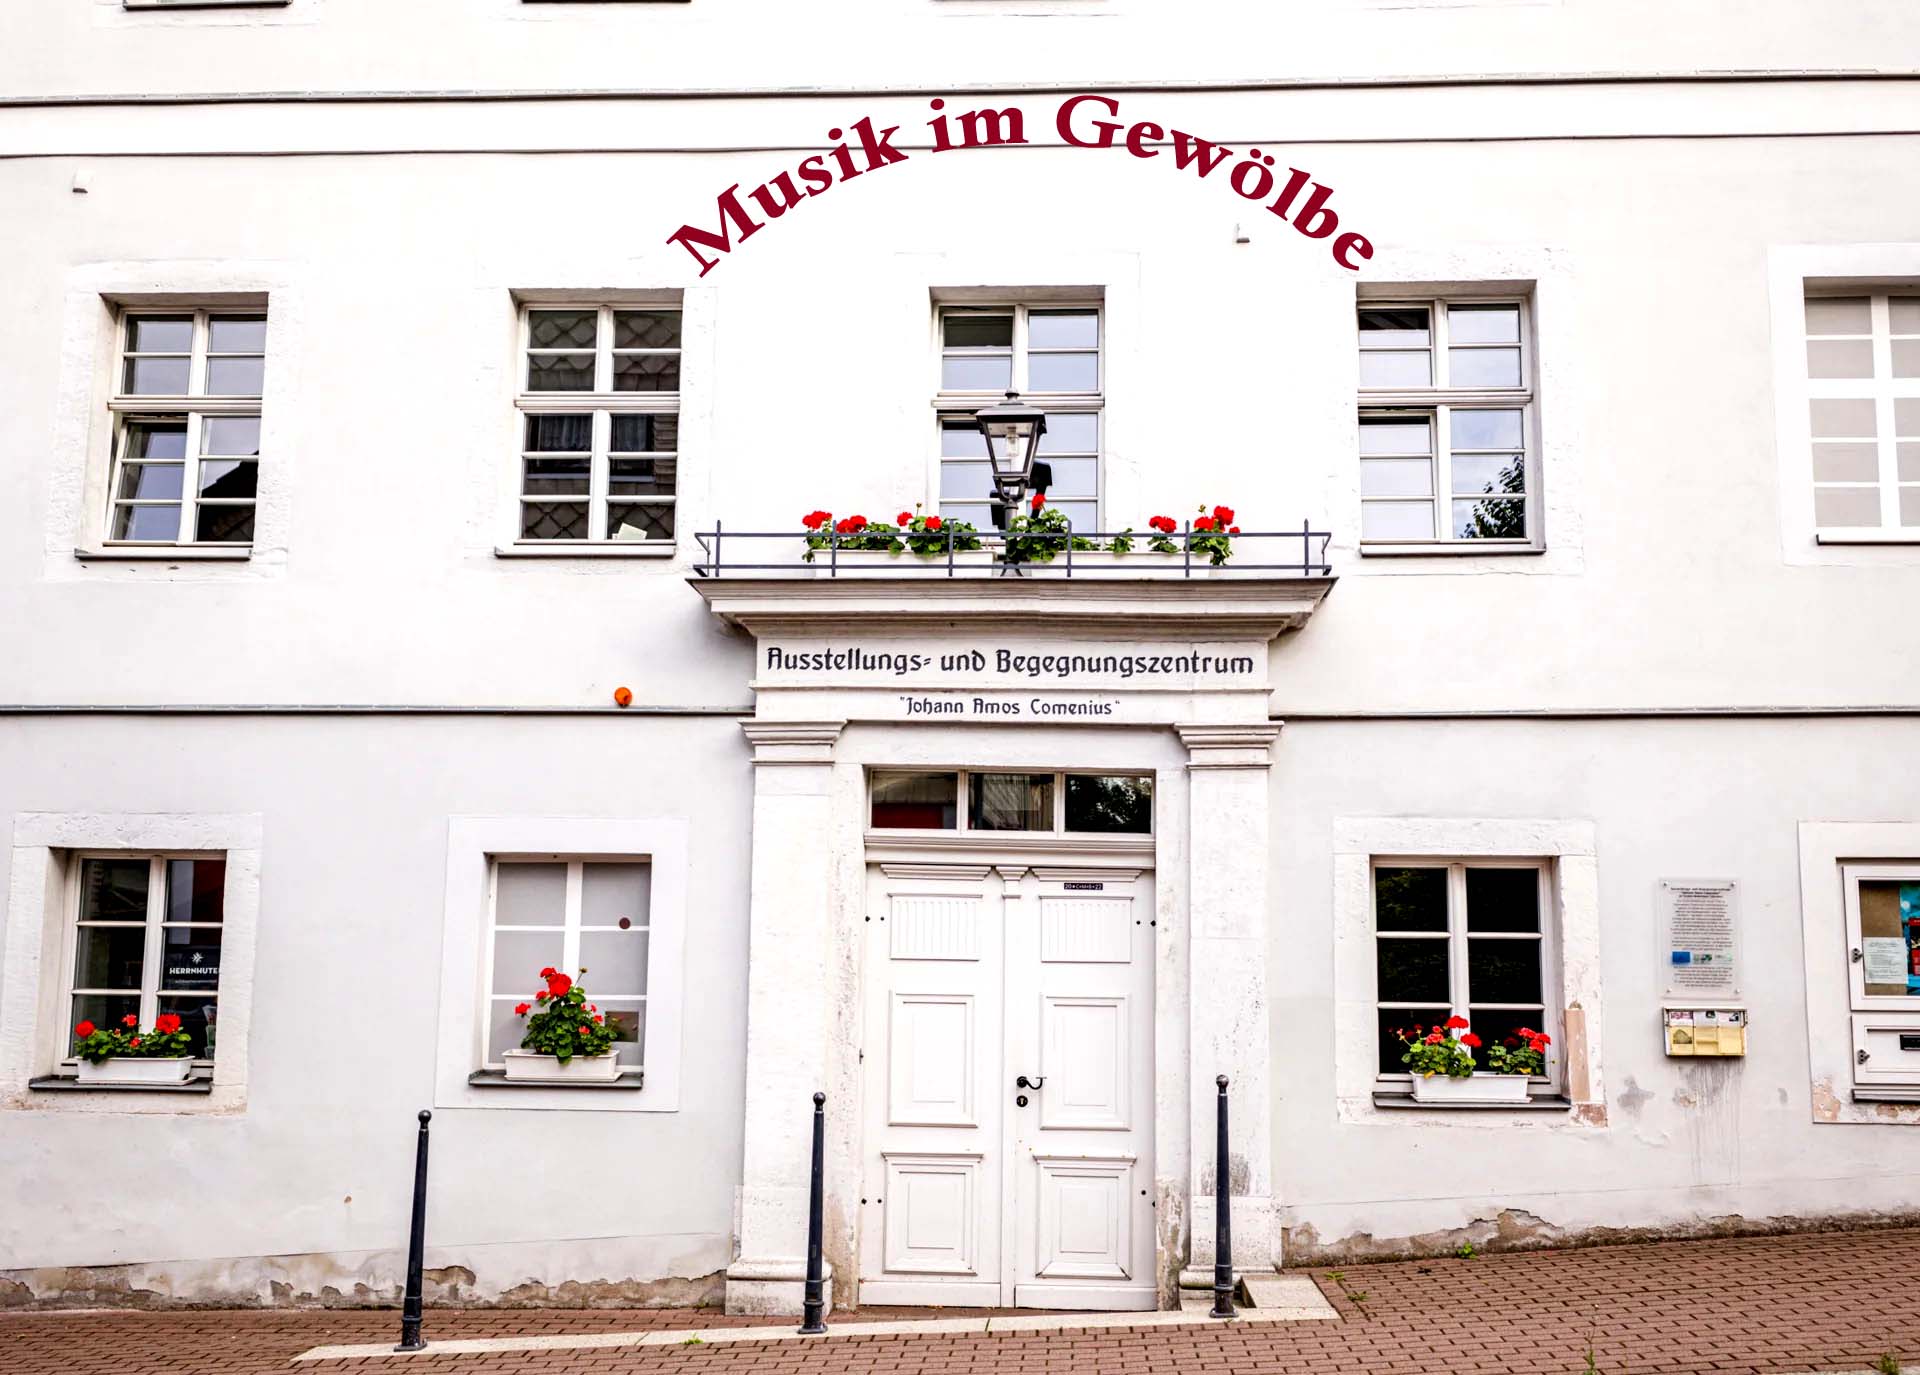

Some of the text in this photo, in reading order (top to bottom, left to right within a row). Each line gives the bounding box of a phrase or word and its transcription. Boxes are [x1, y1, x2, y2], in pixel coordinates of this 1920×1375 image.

[940, 649, 987, 673] und
[995, 647, 1254, 679] Begegnungszentrum
[973, 697, 1020, 716] Amos
